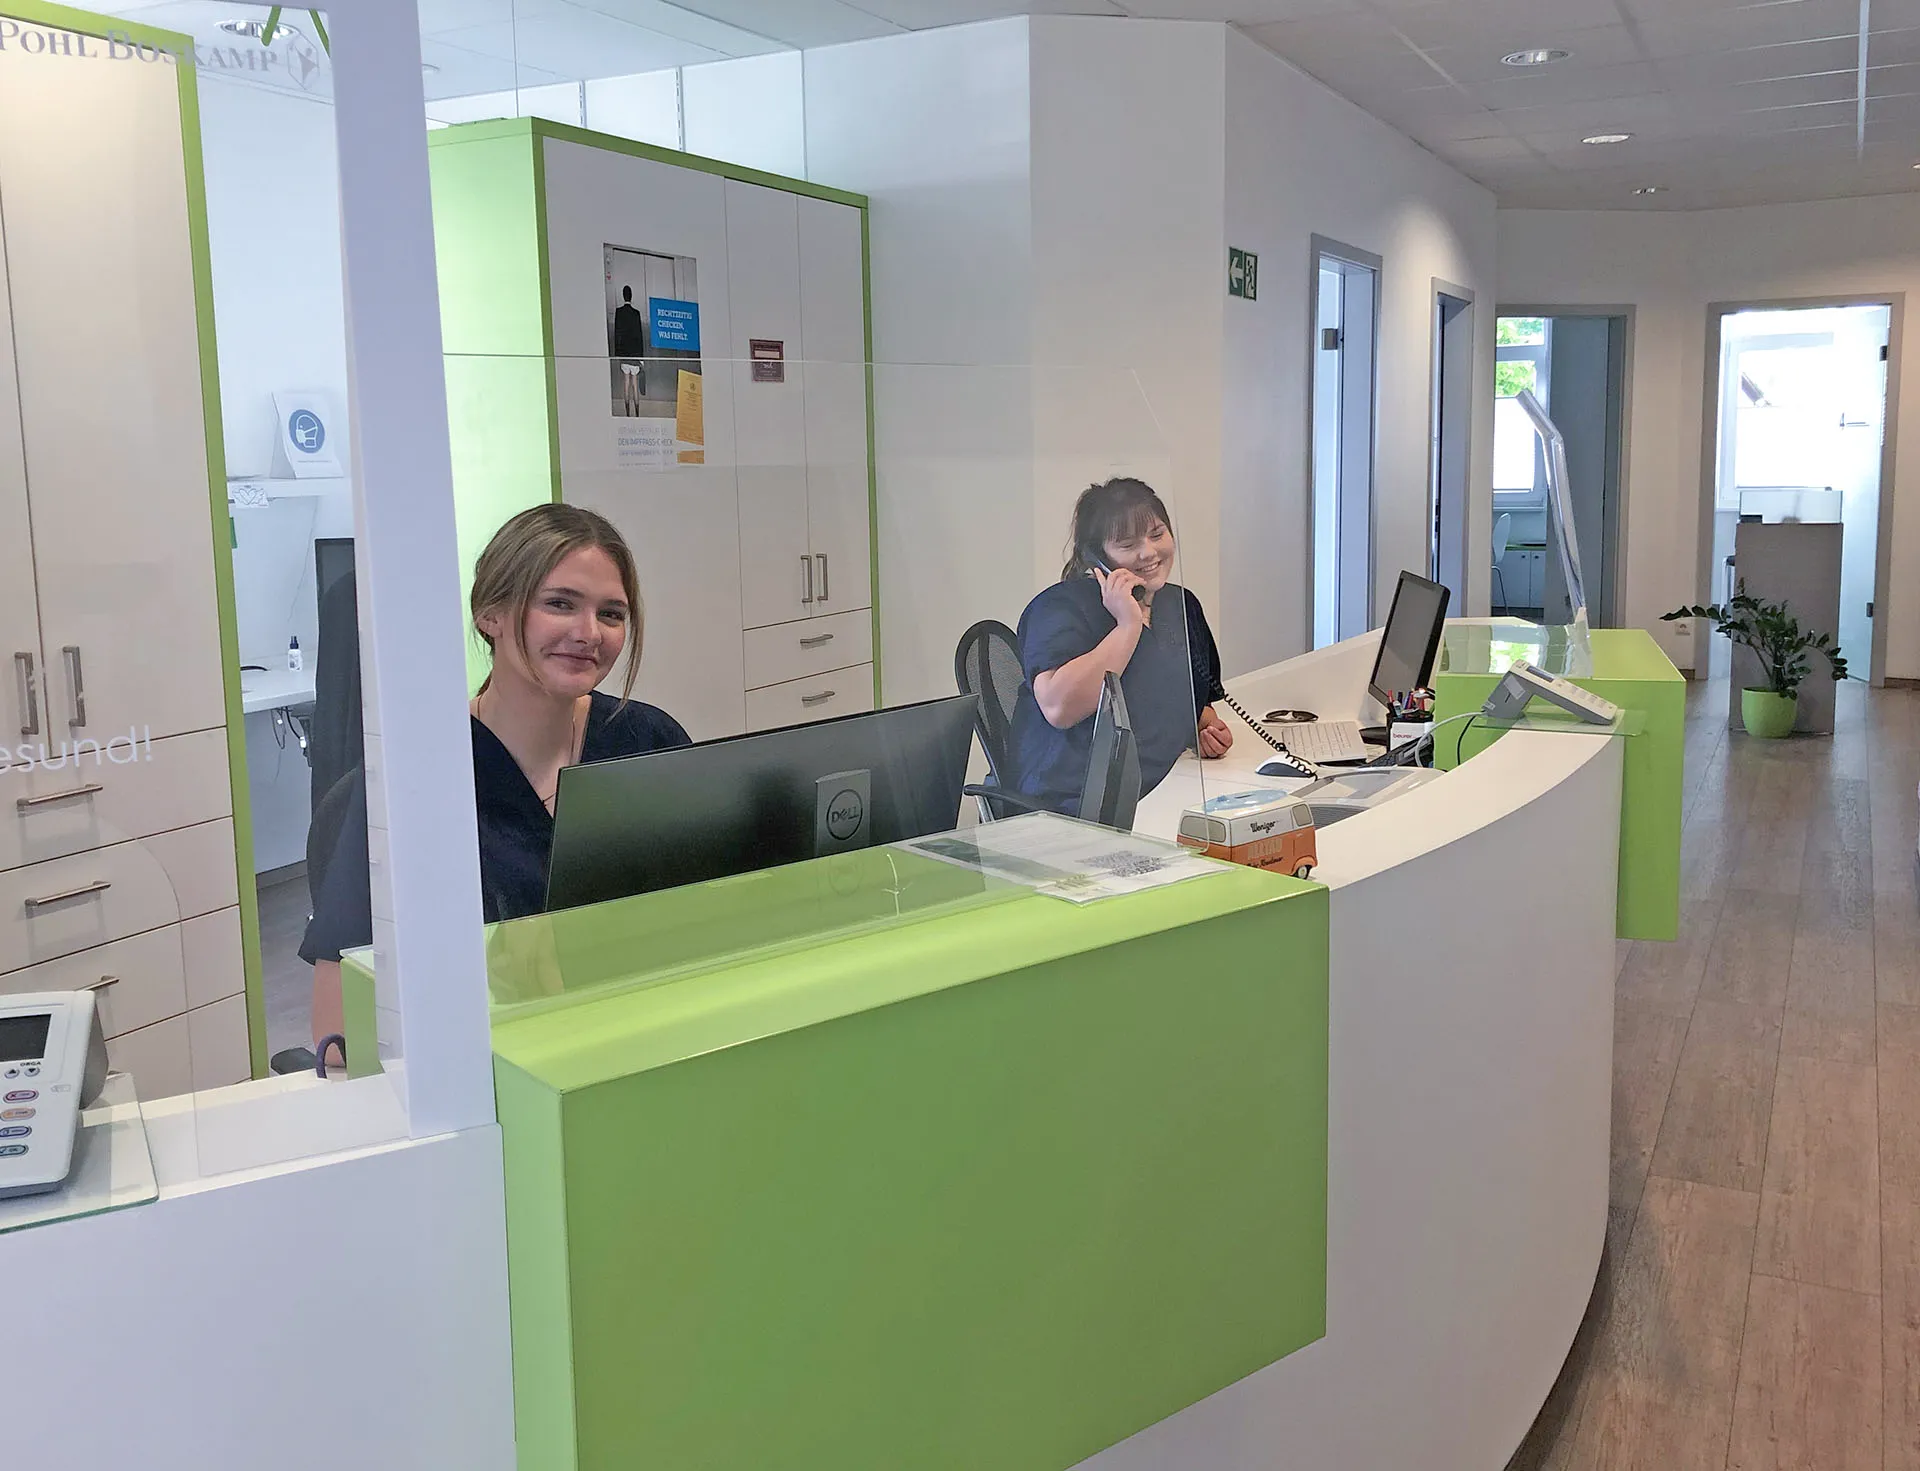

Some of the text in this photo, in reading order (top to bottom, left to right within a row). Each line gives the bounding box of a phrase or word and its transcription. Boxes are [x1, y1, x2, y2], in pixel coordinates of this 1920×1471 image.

[0, 19, 97, 58] POHL
[658, 331, 670, 339] WAS
[831, 806, 859, 823] DELL
[1250, 821, 1276, 833] Weniger
